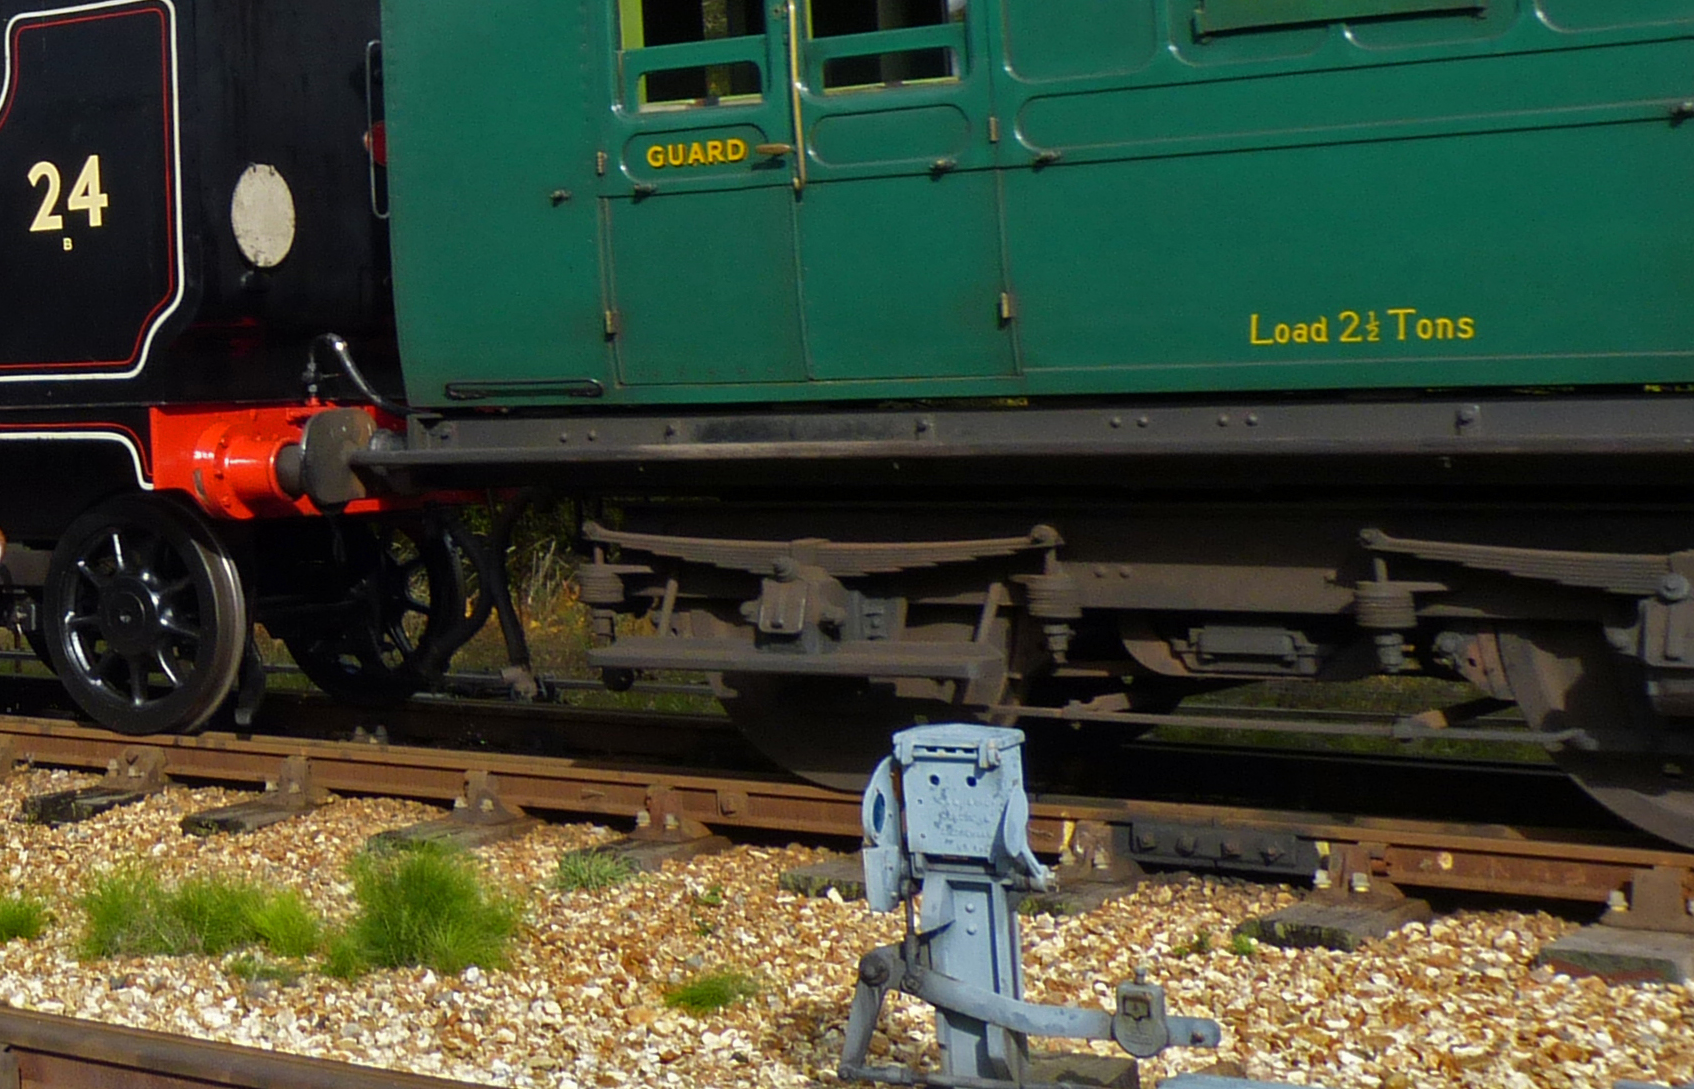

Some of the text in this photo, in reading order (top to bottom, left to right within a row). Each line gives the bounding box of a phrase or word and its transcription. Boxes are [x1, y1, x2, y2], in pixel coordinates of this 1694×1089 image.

[646, 138, 749, 168] GUARD
[27, 154, 109, 232] 24
[62, 237, 73, 251] B
[1249, 313, 1329, 345] Load
[1387, 308, 1475, 341] Tons
